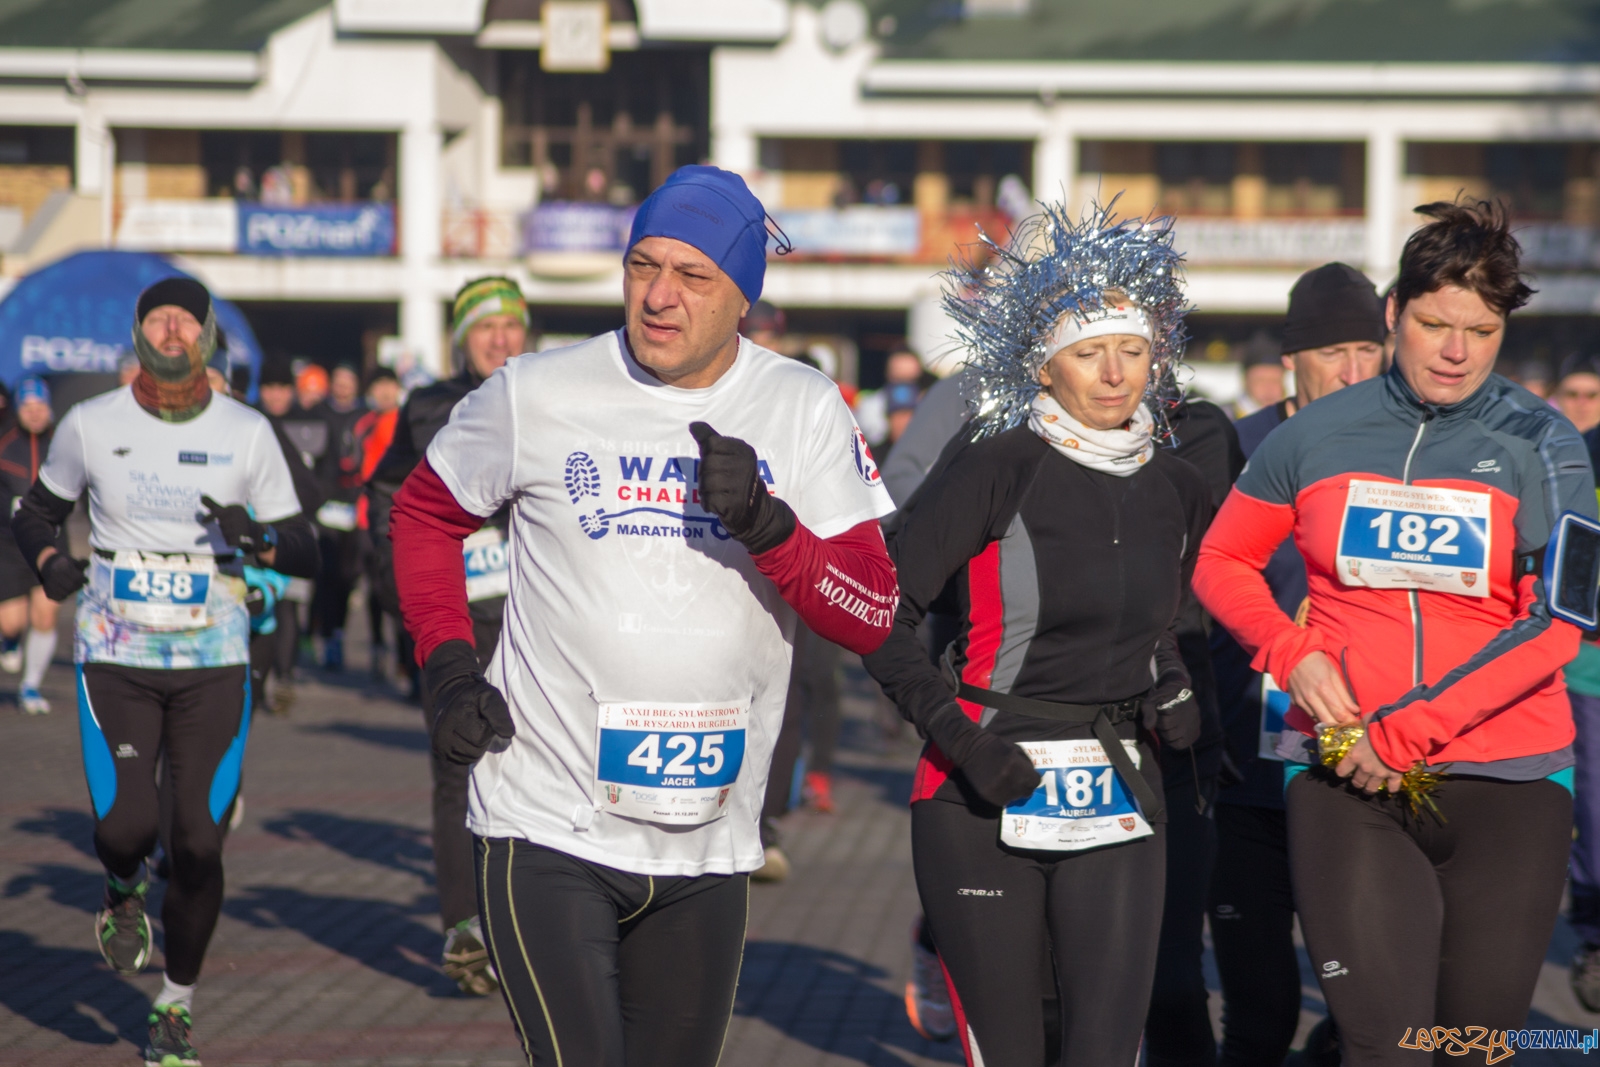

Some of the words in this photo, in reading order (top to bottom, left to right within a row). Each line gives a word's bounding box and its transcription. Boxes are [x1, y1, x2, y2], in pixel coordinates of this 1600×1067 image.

[619, 456, 775, 485] WAA
[618, 486, 775, 504] CHALL
[1366, 487, 1388, 496] XXXII
[1390, 489, 1410, 498] BIEG
[1411, 492, 1477, 505] SYLWESROWY
[1382, 499, 1426, 511] RYSZARDA
[617, 524, 704, 538] MARATHON
[1370, 511, 1459, 555] 182
[468, 541, 510, 572] 40
[1391, 551, 1433, 563] MONIKA
[128, 571, 193, 600] 458
[814, 576, 891, 628] LECHITÓW
[622, 707, 650, 716] XXXII
[653, 709, 676, 717] BIEG
[678, 707, 740, 718] SYLWESTROWY
[643, 720, 696, 728] RYSZARDA
[698, 718, 737, 728] BURGIELA
[627, 734, 724, 775] 425
[661, 777, 696, 787] JACEK
[1036, 767, 1113, 808] 181
[1059, 808, 1096, 818] AURELIA
